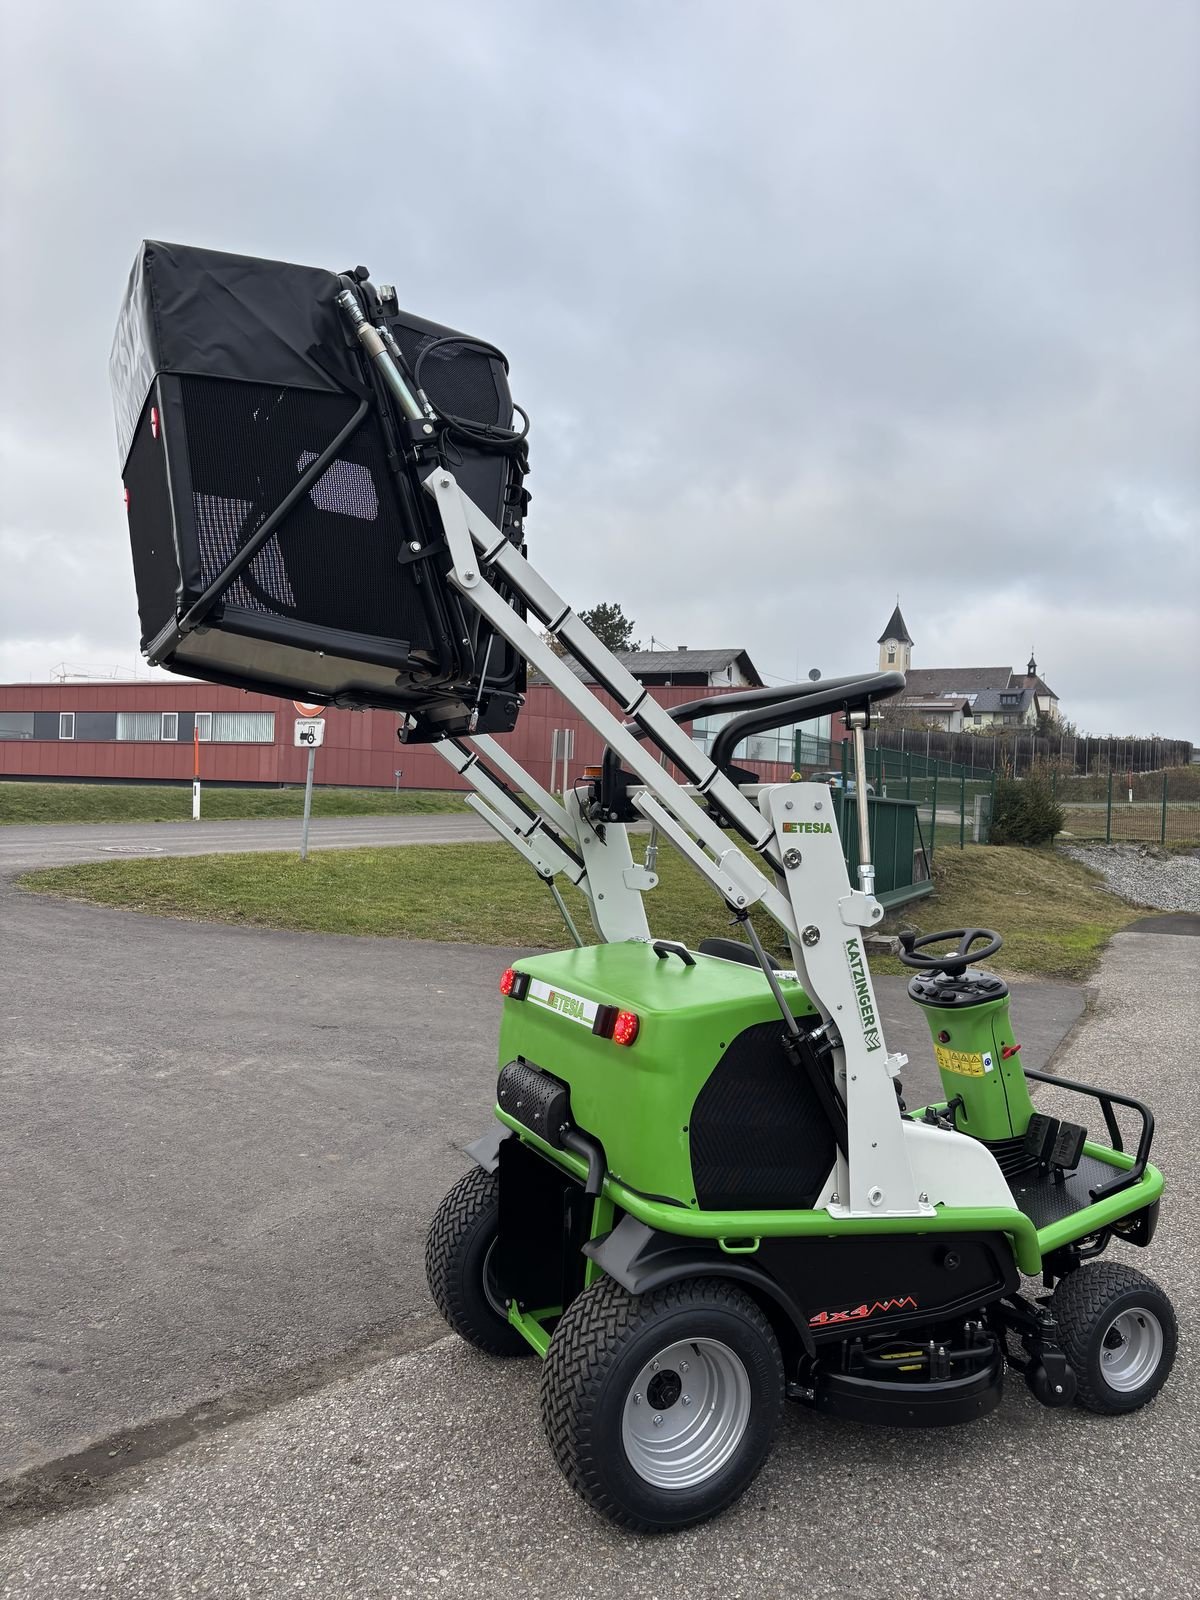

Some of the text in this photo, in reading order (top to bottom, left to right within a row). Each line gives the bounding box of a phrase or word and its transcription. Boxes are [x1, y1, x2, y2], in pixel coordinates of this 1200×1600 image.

[782, 822, 833, 833] ETESIA
[846, 938, 875, 1028] KATZINGER
[809, 1304, 868, 1322] 4x4
